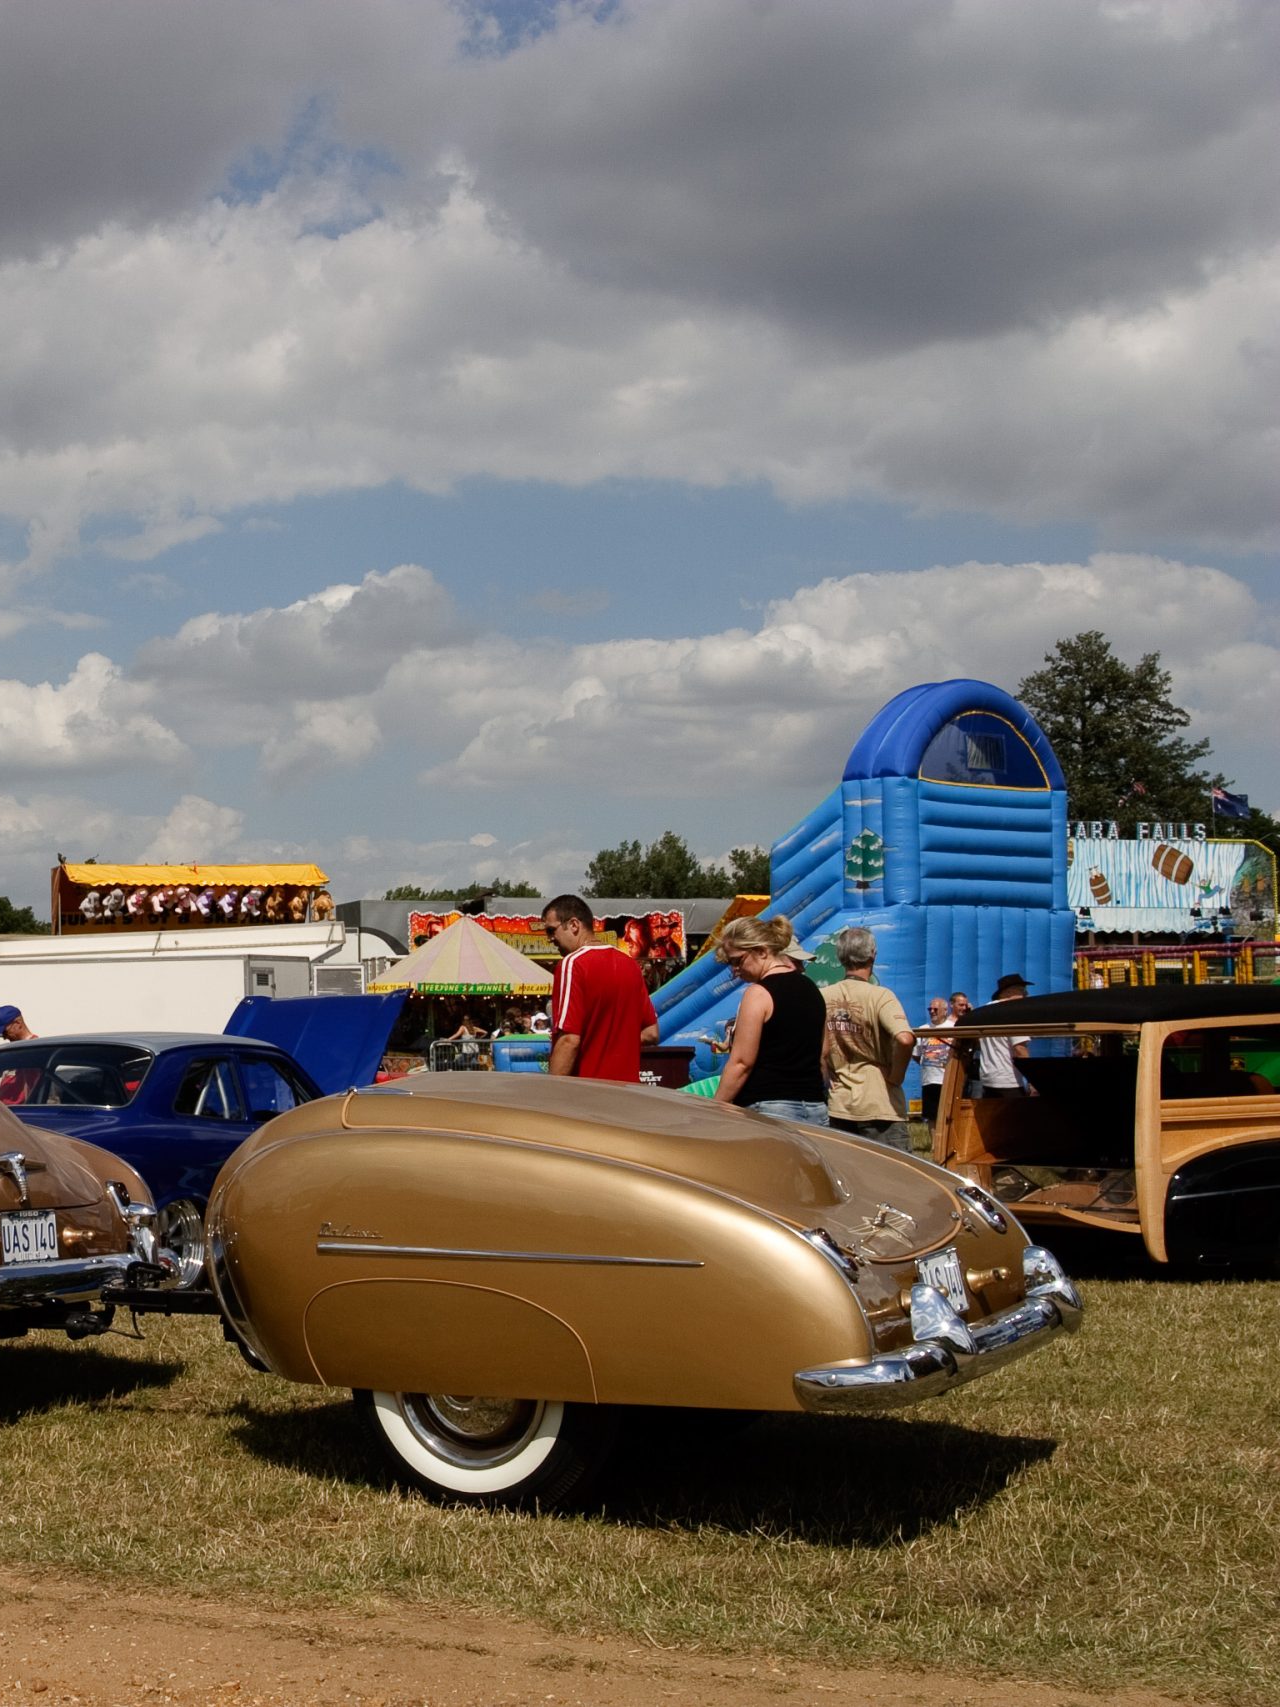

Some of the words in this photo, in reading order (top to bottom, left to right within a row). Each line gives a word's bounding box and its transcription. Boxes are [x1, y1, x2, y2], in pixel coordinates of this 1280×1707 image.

[1137, 822, 1207, 841] FALLS
[3, 1223, 30, 1253] UAS
[35, 1222, 56, 1251] 140
